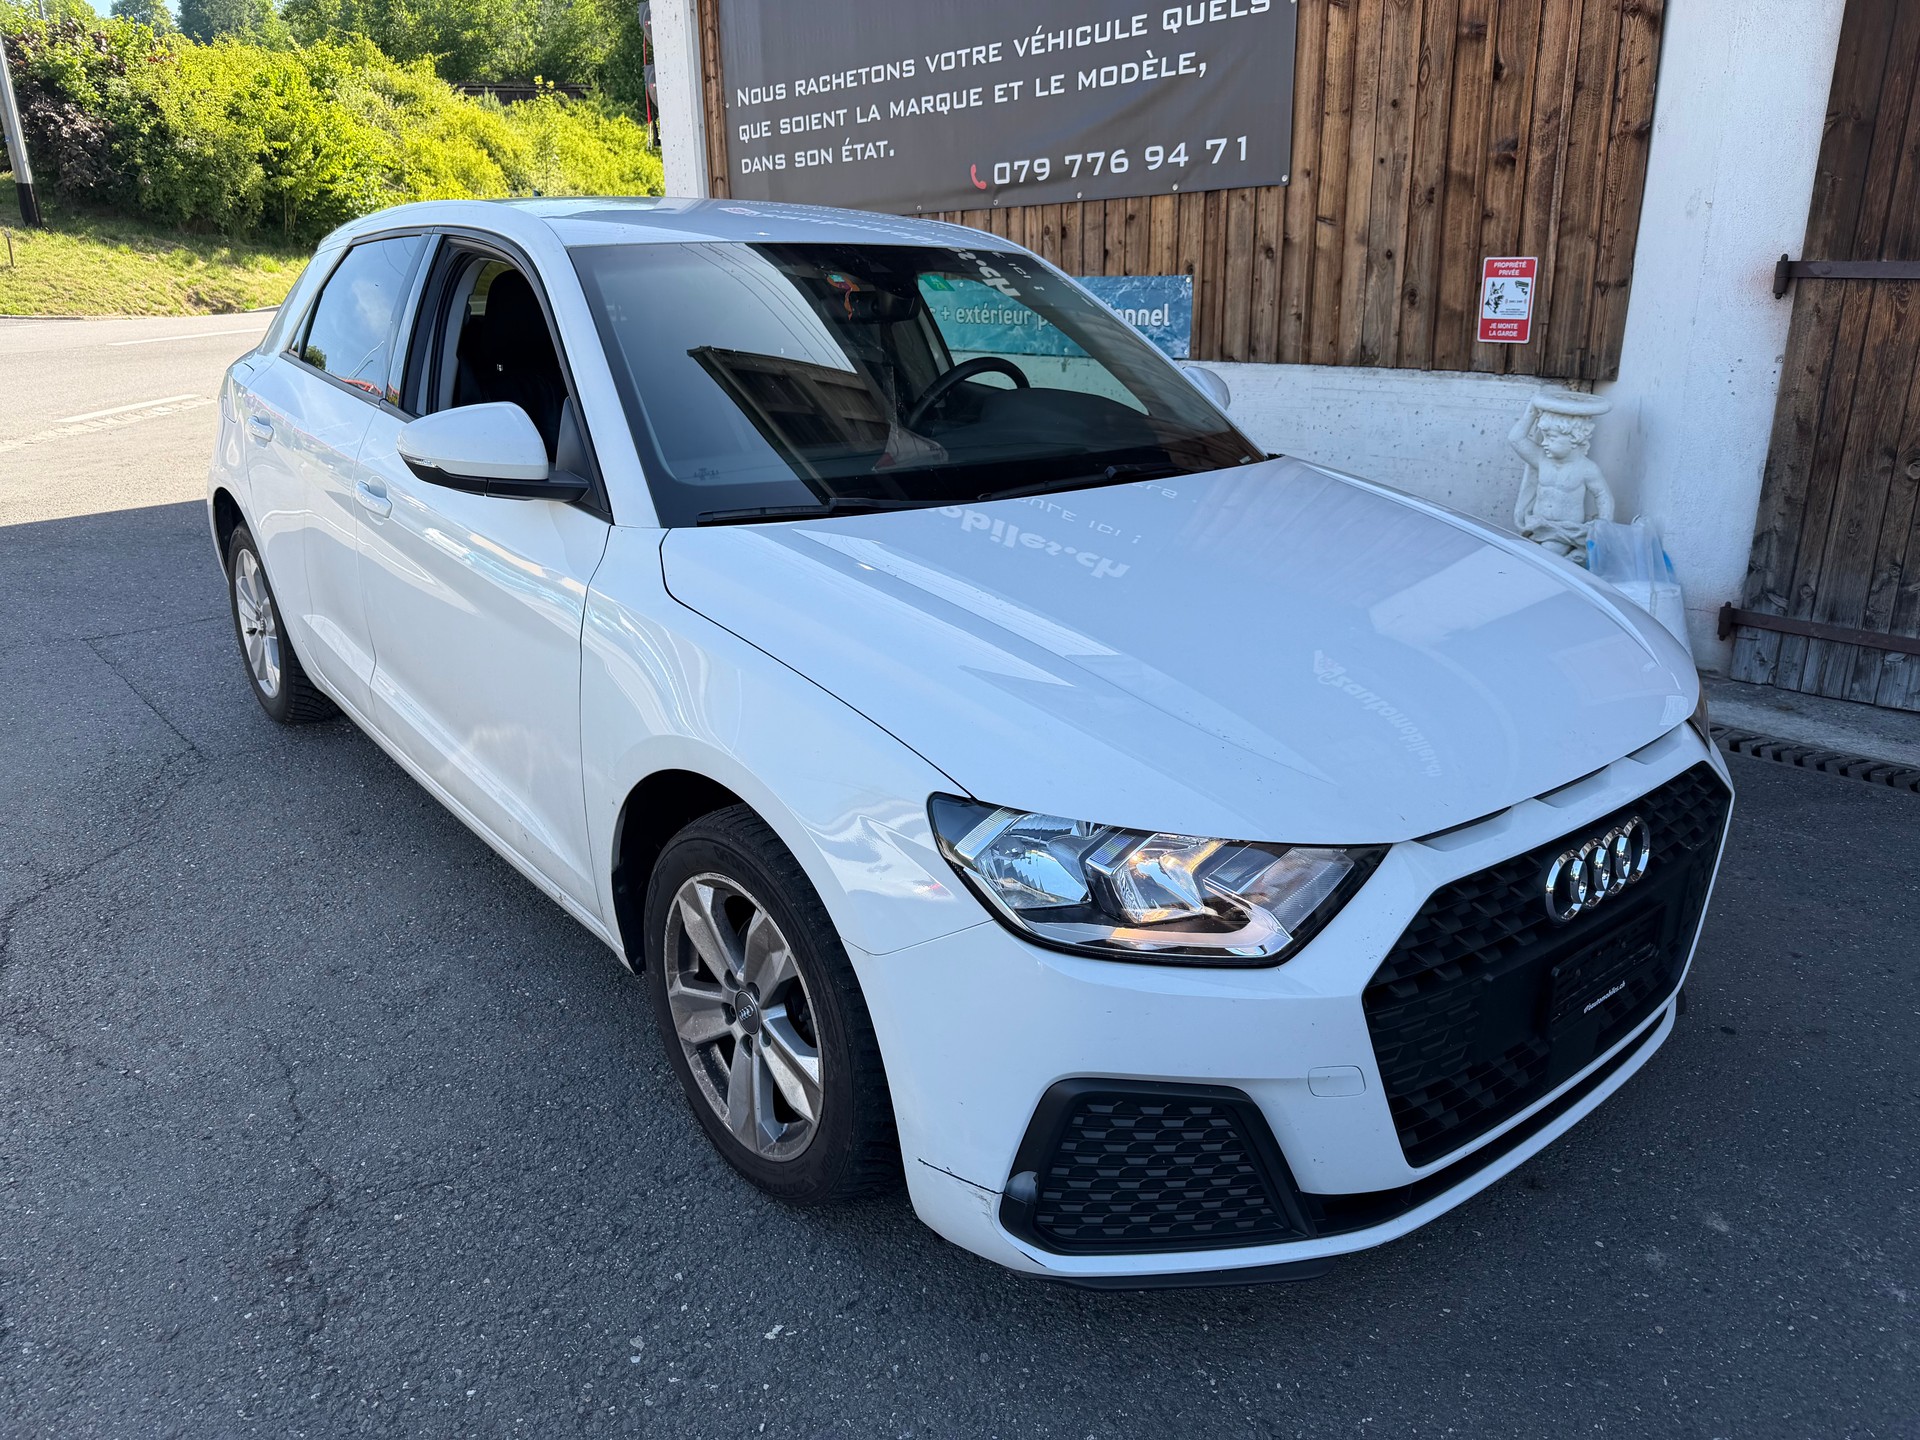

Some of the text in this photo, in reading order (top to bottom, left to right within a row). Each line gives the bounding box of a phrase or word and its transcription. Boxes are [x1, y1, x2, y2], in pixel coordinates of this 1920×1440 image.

[795, 59, 915, 96] RACHETONS
[925, 42, 1002, 72] VOTRE
[1014, 15, 1148, 57] VÉHICULE
[1163, 0, 1270, 33] QUELS
[739, 50, 1206, 143] QUE SOIENT LA MARQUE ET LE MODÈLE,
[742, 137, 894, 174] DANS SON ÉTAT.
[994, 136, 1246, 184] 079 776 94 71
[955, 303, 1032, 325] extérieur
